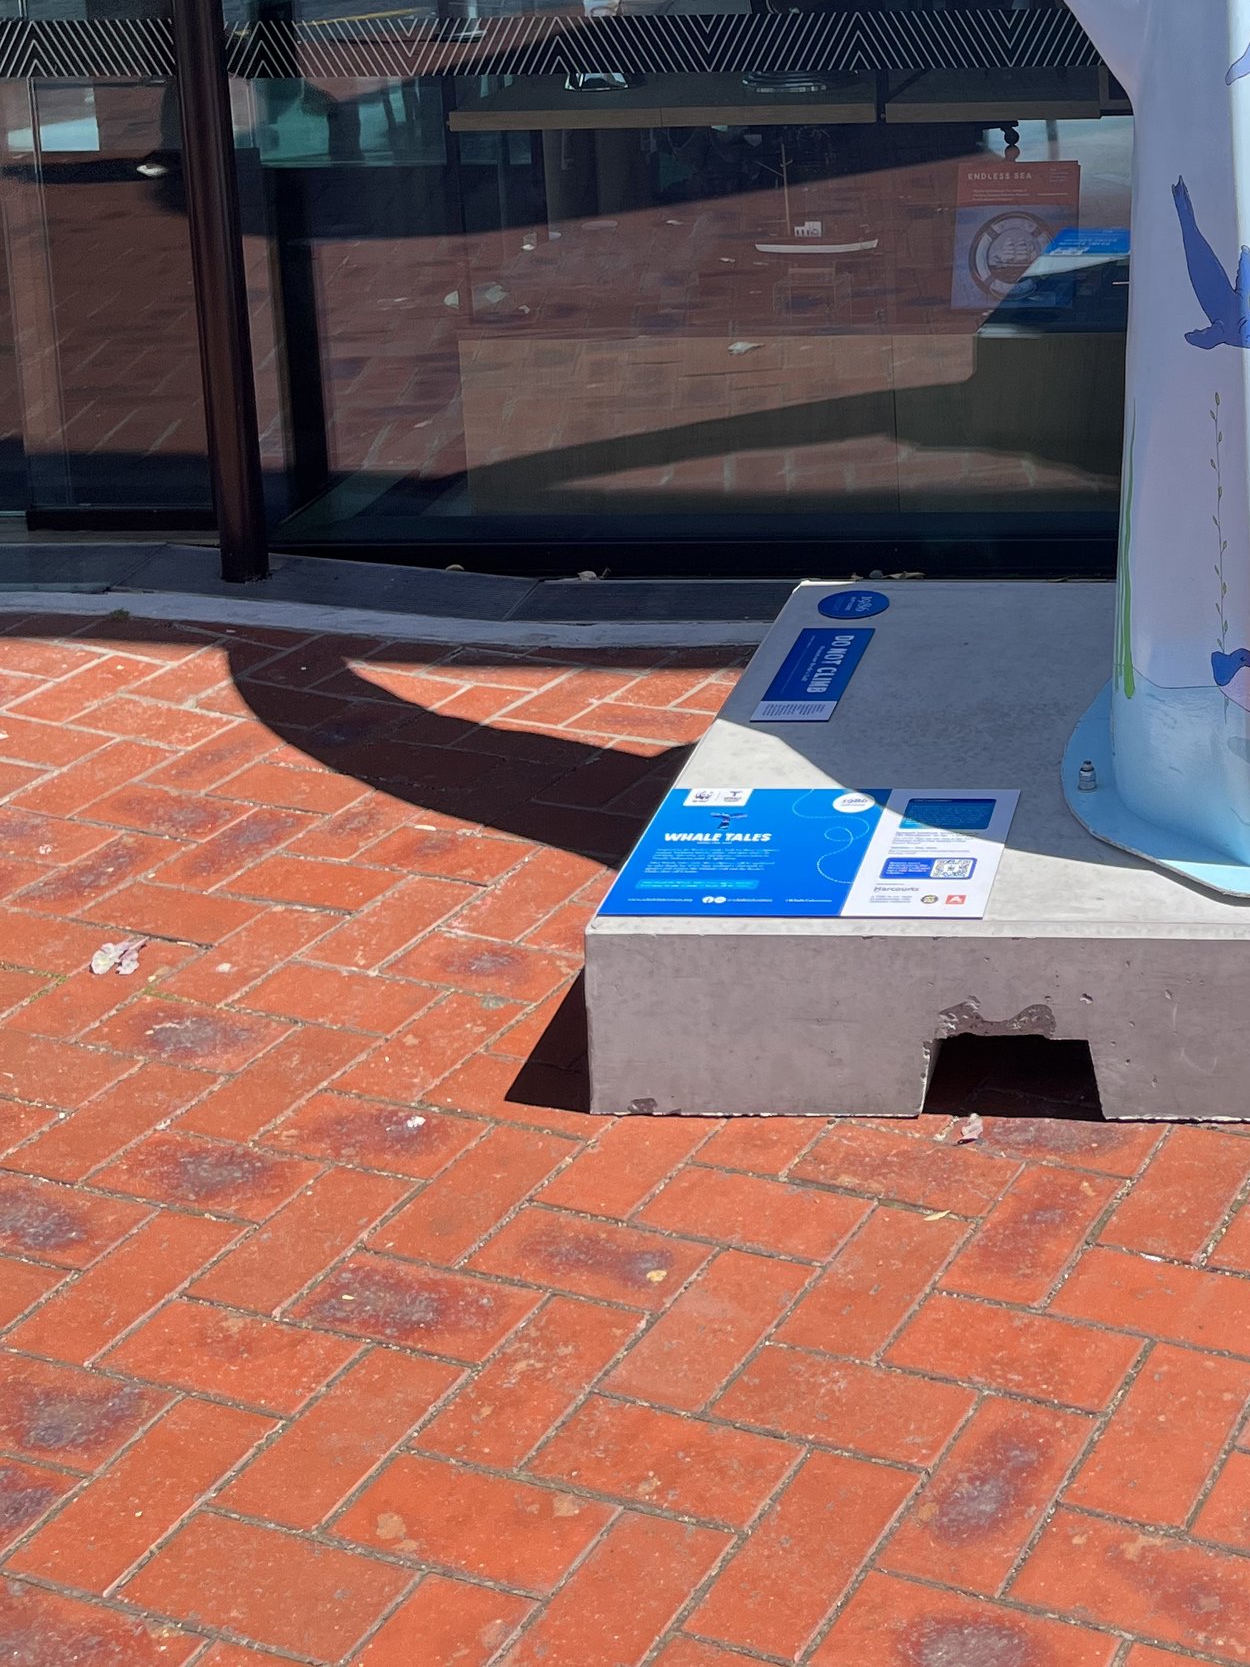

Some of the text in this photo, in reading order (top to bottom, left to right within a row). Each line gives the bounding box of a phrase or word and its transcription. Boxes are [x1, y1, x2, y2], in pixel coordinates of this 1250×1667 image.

[967, 172, 1033, 181] ENDLESS SEA
[831, 635, 855, 647] DO
[821, 648, 848, 665] NOT
[806, 666, 838, 693] CLIMB
[664, 832, 772, 842] WHALE TALES
